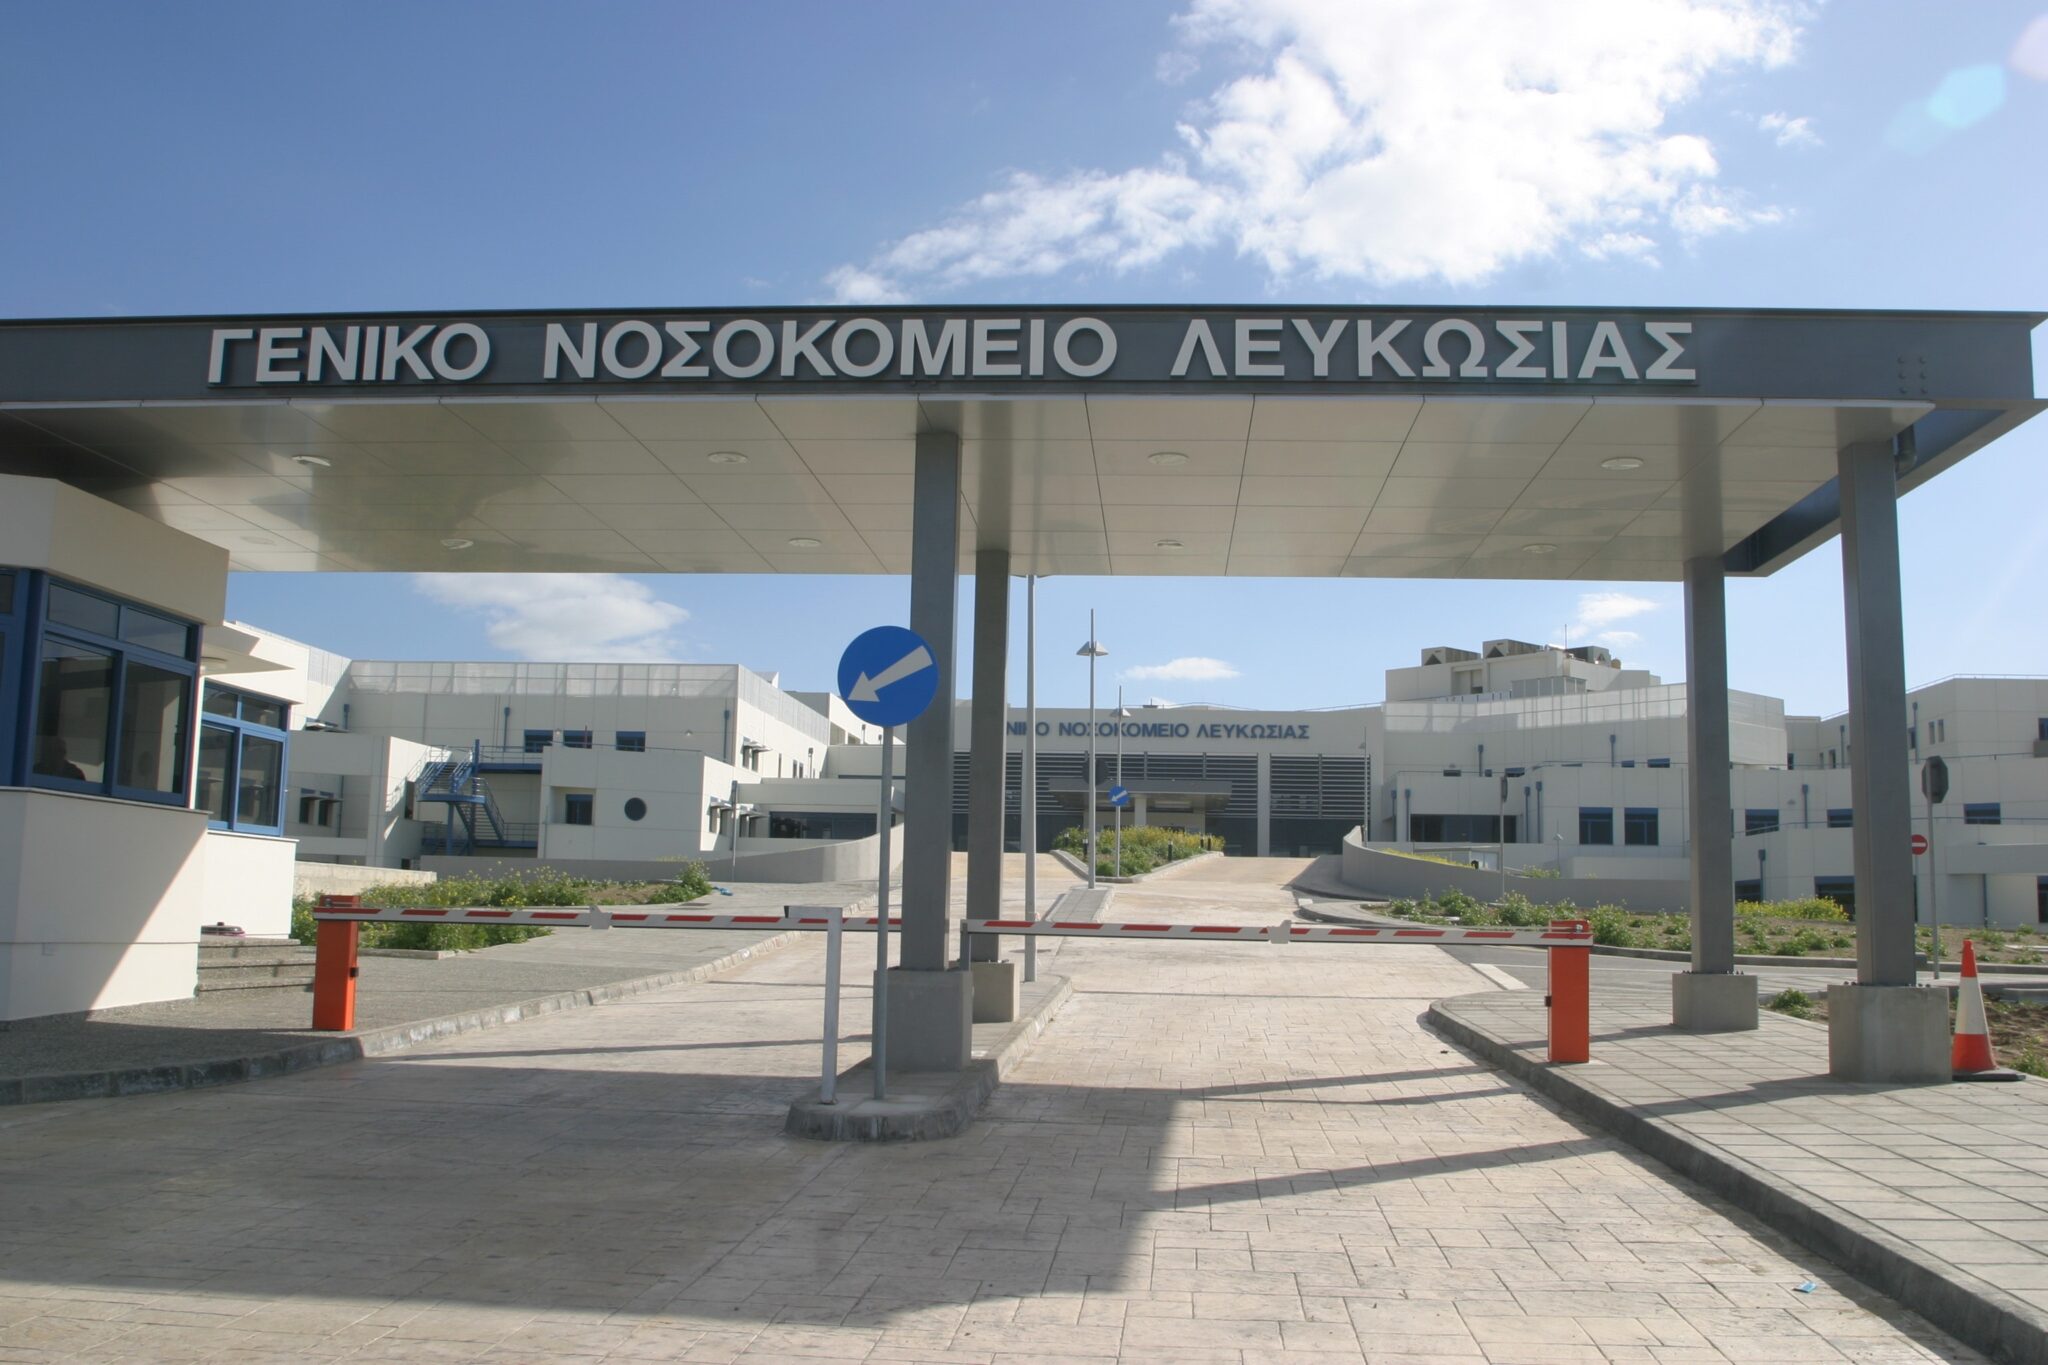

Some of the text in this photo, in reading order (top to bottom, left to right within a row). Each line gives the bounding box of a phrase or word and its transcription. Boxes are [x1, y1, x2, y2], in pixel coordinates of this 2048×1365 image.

[207, 317, 1697, 385] ΓΕΝΙΚΟ ΝΟΣΟΚΟΜΕΙΟ ΛΕΥΚΩΣΙΑΣ
[1196, 723, 1310, 740] ΛΕΥΚΩΣΙΑΣ
